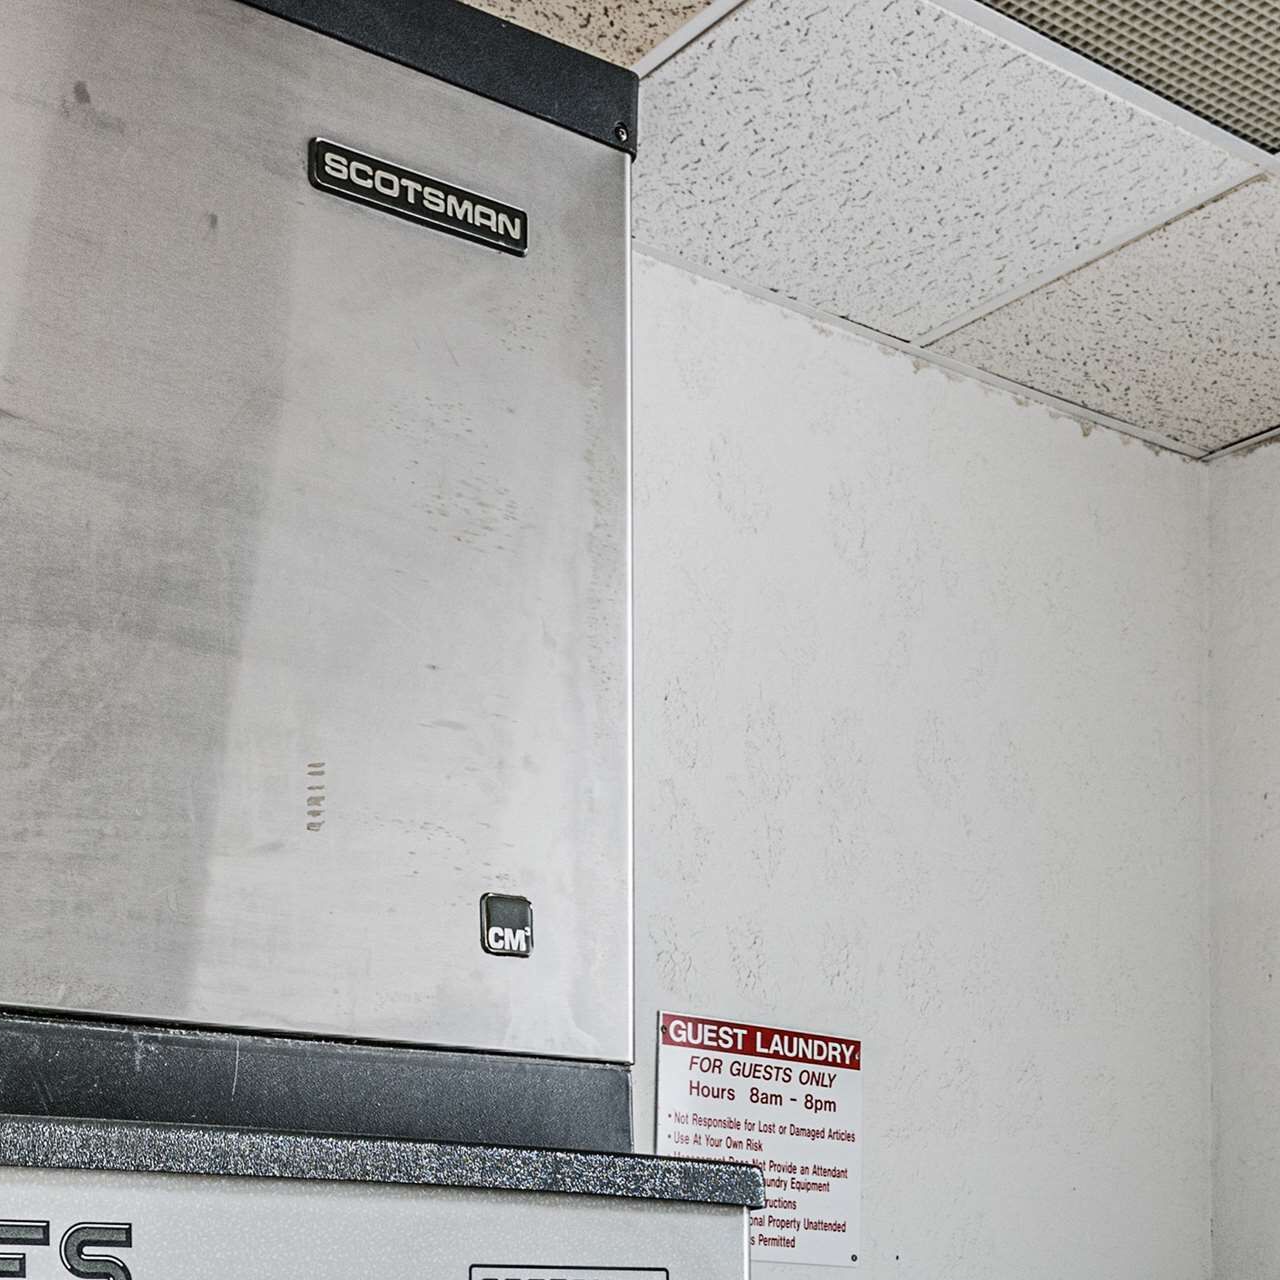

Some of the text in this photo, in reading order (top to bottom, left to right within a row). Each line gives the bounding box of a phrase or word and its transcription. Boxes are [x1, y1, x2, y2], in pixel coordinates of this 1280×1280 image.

[323, 152, 521, 240] SCOTSMAN
[669, 1019, 855, 1065] GUEST LAUNDRY
[689, 1055, 837, 1088] FOR GUESTS ONLY
[689, 1080, 736, 1101] Hours
[749, 1087, 783, 1106] 8am
[804, 1094, 837, 1114] 8pm
[674, 1111, 856, 1143] Not Responsible for Lost or Damaged Articles
[673, 1131, 763, 1152] Use At Your Own Risk
[768, 1160, 797, 1174] Provide
[800, 1165, 810, 1175] an
[812, 1164, 848, 1179] Attendant
[764, 1176, 830, 1192] undry Equipment
[768, 1215, 801, 1232] Property
[803, 1218, 847, 1233] Unattended
[758, 1234, 796, 1248] Permitted
